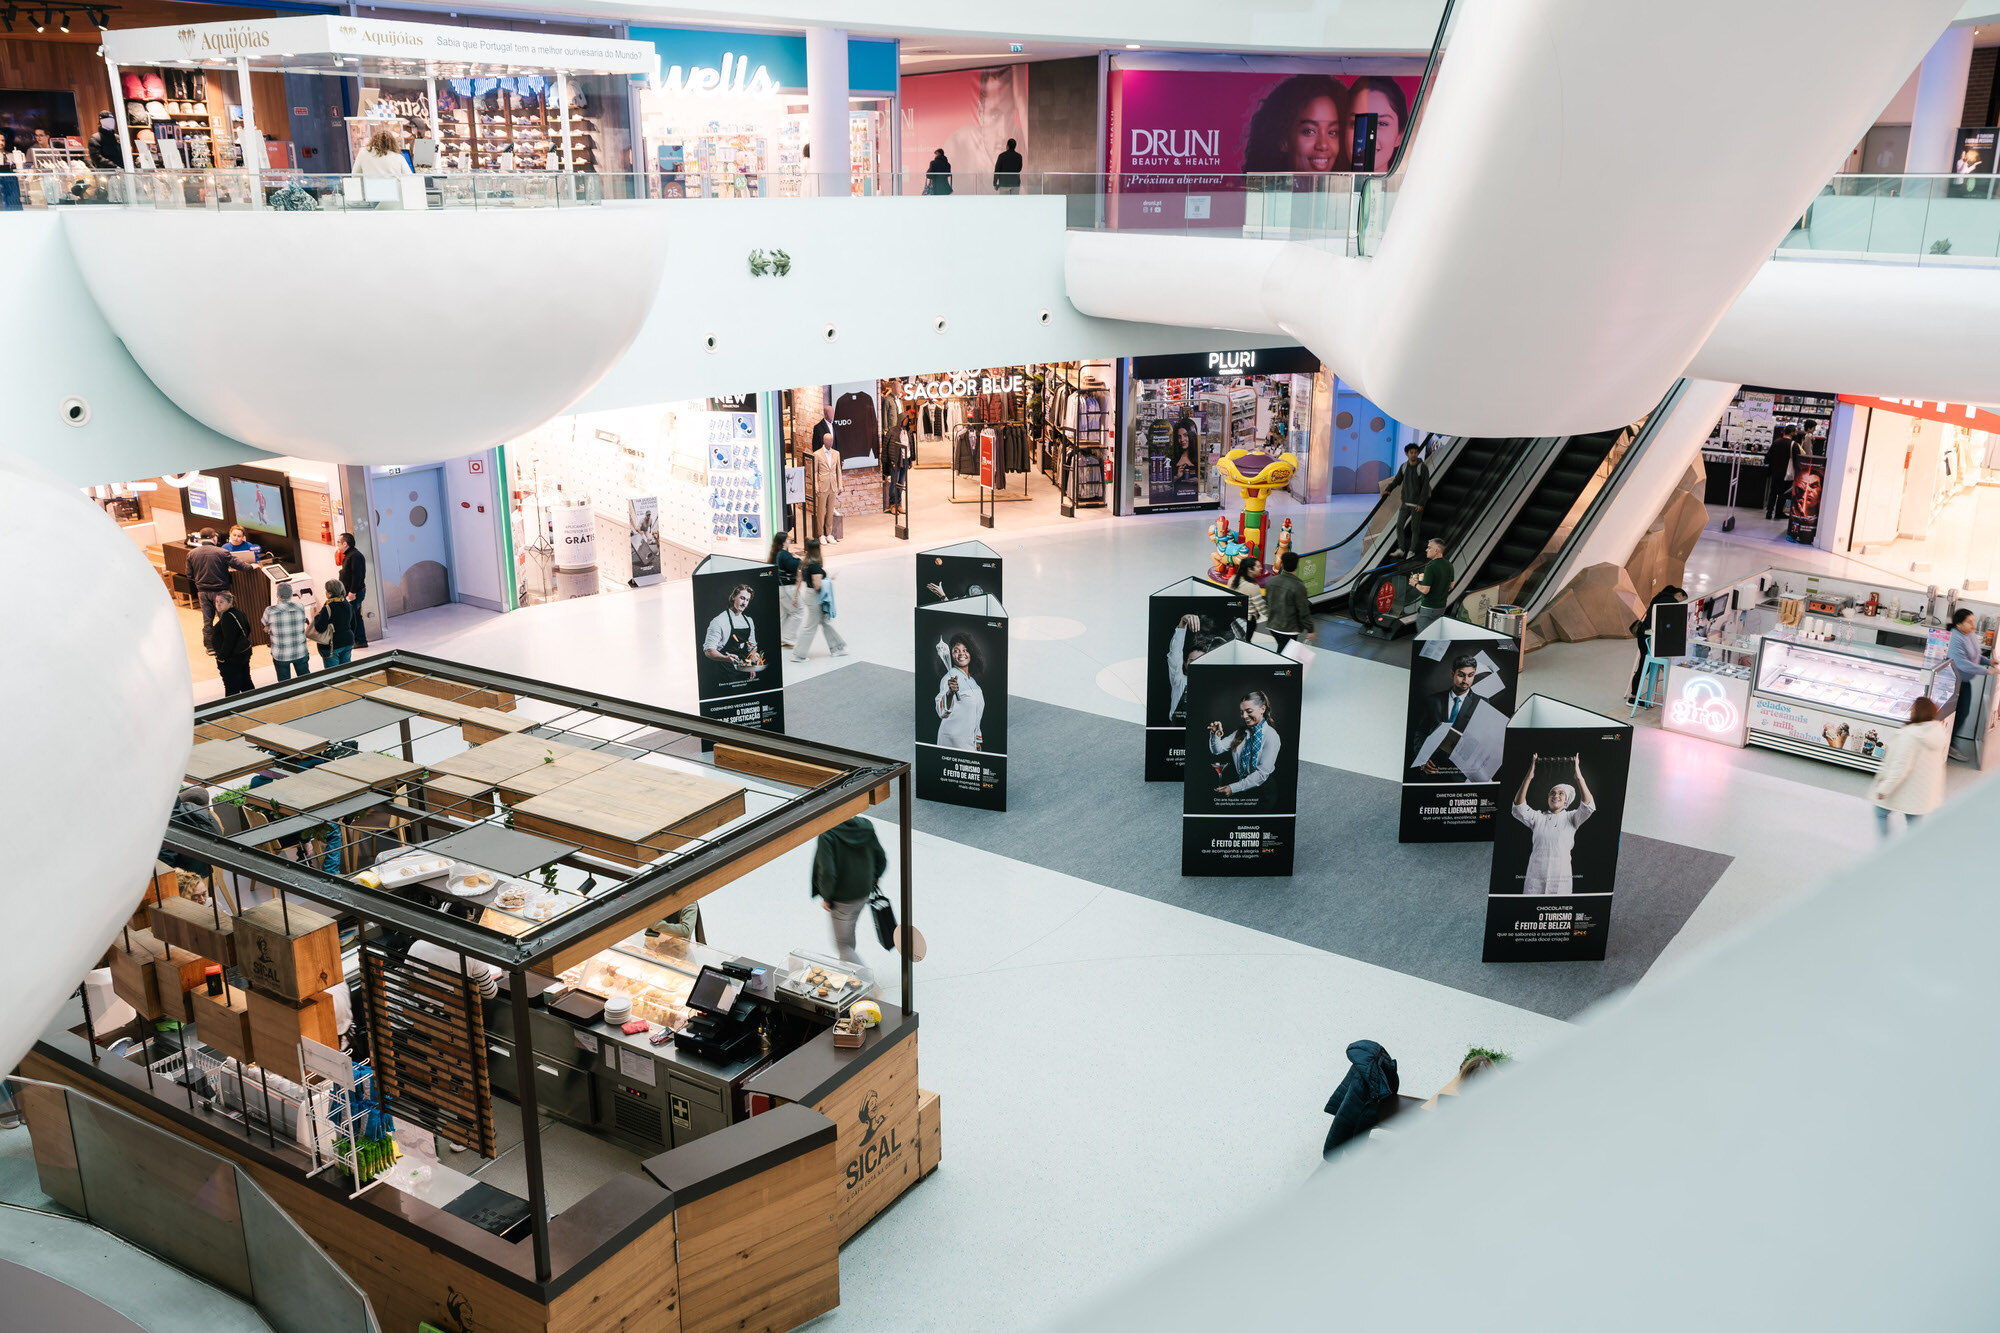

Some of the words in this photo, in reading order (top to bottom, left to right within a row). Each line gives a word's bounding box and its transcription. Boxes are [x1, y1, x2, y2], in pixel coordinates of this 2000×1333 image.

[201, 26, 270, 54] Aquijóias
[362, 29, 424, 46] Aquijóias
[436, 36, 460, 48] Sabia
[462, 40, 478, 51] que
[480, 40, 513, 54] Portugal
[514, 44, 530, 53] tem
[538, 45, 563, 55] melhor
[564, 46, 604, 58] ourivesaria
[604, 49, 614, 59] do
[614, 50, 642, 61] Mundo?
[878, 108, 914, 131] DNI
[1131, 129, 1220, 157] DRUNI
[1126, 174, 1174, 188] ¡Próxima
[1176, 174, 1224, 184] abertura!
[1208, 351, 1256, 369] PLURI
[904, 379, 978, 401] SACOOR
[982, 376, 1023, 394] BLUE
[714, 394, 747, 404] NEW
[741, 706, 760, 715] TURISMO
[1756, 699, 1791, 713] gelados
[730, 713, 760, 723] SOFISTICAÇÃO
[1760, 708, 1808, 724] artesanais
[1773, 720, 1794, 731] milk
[1788, 729, 1822, 743] shakes
[943, 768, 947, 776] É
[947, 770, 960, 778] FEITO
[959, 764, 980, 774] TURISMO
[1420, 806, 1423, 814] É
[1448, 806, 1477, 814] LIDERANÇA
[1212, 839, 1215, 847] É
[1545, 913, 1572, 921] TURISMO
[1515, 921, 1519, 929] É
[253, 961, 280, 983] SICAL
[846, 1128, 901, 1189] SICAL
